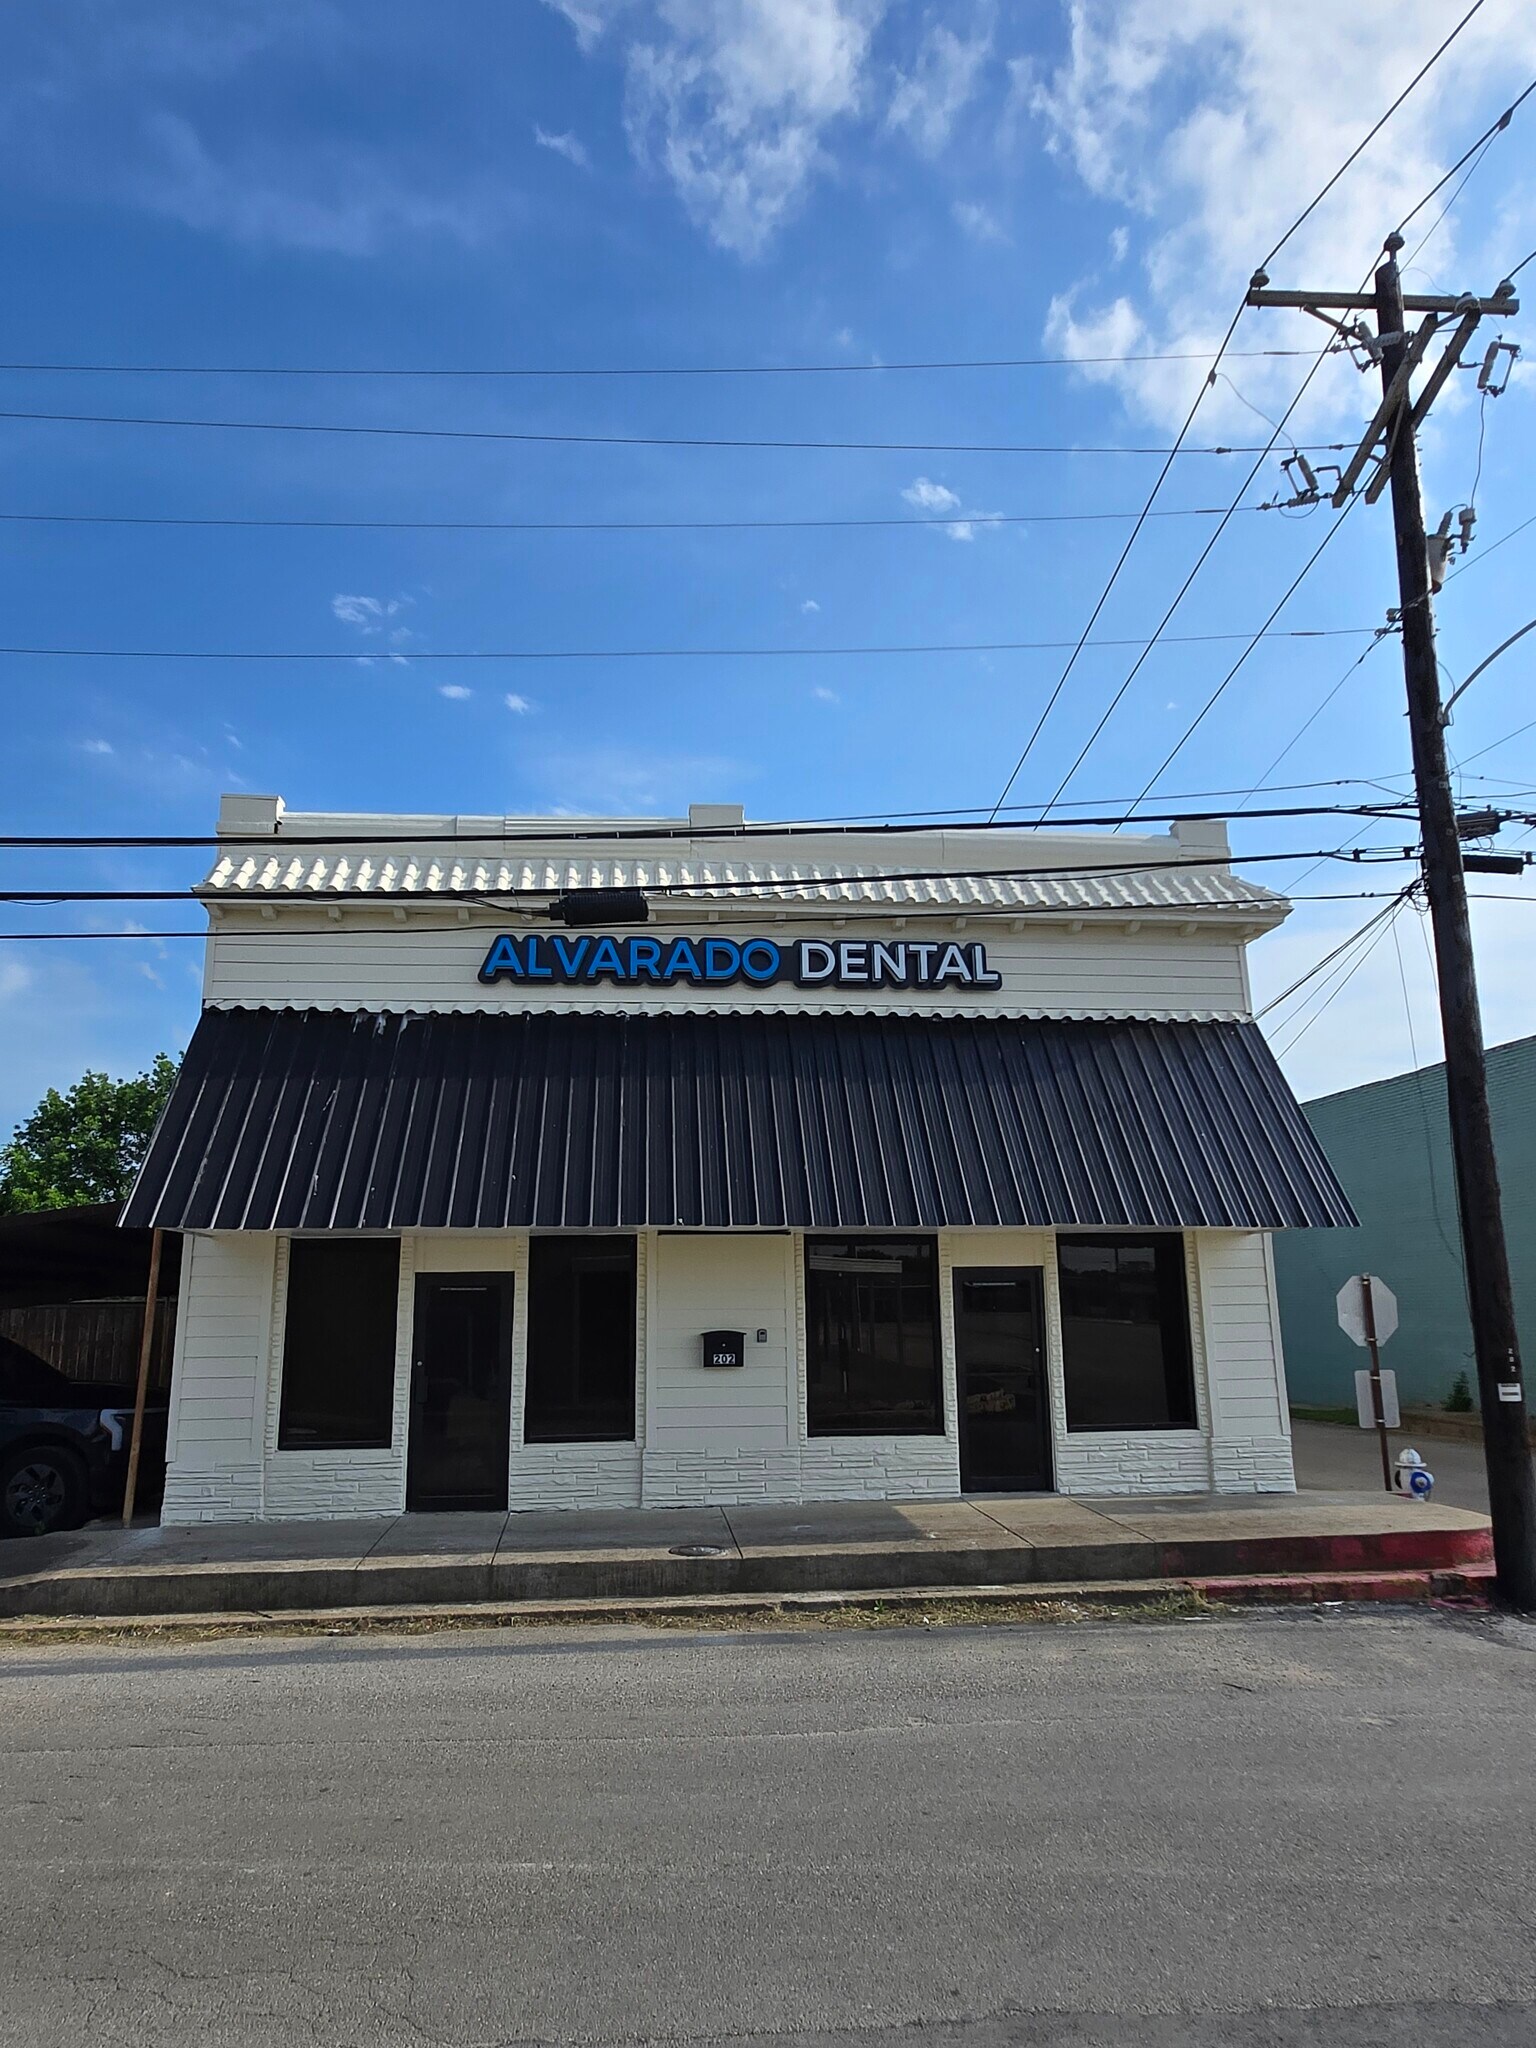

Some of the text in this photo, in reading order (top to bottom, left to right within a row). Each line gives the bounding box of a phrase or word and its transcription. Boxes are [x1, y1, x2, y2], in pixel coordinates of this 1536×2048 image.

[484, 937, 999, 983] ALVARADO DENTAL
[713, 1354, 735, 1364] 202
